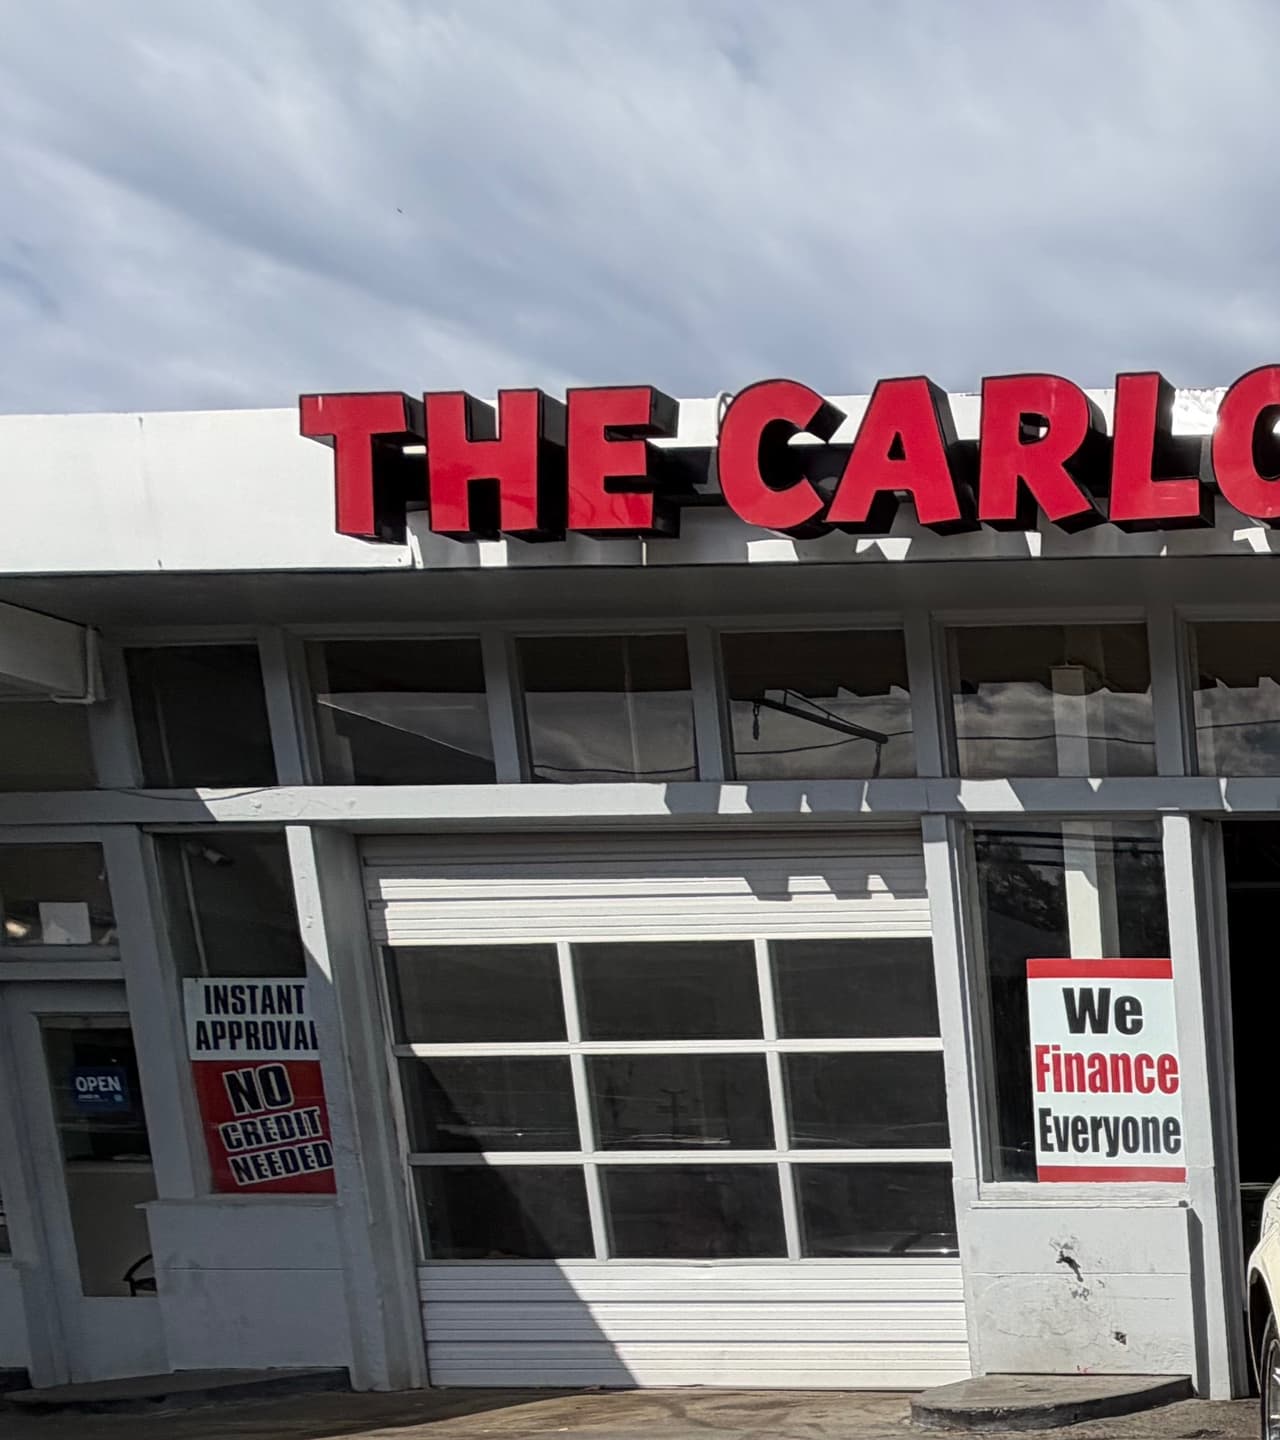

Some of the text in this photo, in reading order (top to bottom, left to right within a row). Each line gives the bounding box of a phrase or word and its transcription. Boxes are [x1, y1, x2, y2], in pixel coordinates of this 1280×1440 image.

[299, 385, 670, 540] THE
[203, 983, 306, 1016] INSTANT
[1061, 986, 1144, 1036] We
[75, 1075, 122, 1092] OPEN
[222, 1062, 295, 1117] NO
[1033, 1044, 1180, 1095] Finance
[219, 1105, 323, 1152] CREDIT
[1037, 1107, 1182, 1158] Everyone
[227, 1140, 335, 1186] NEEDED
